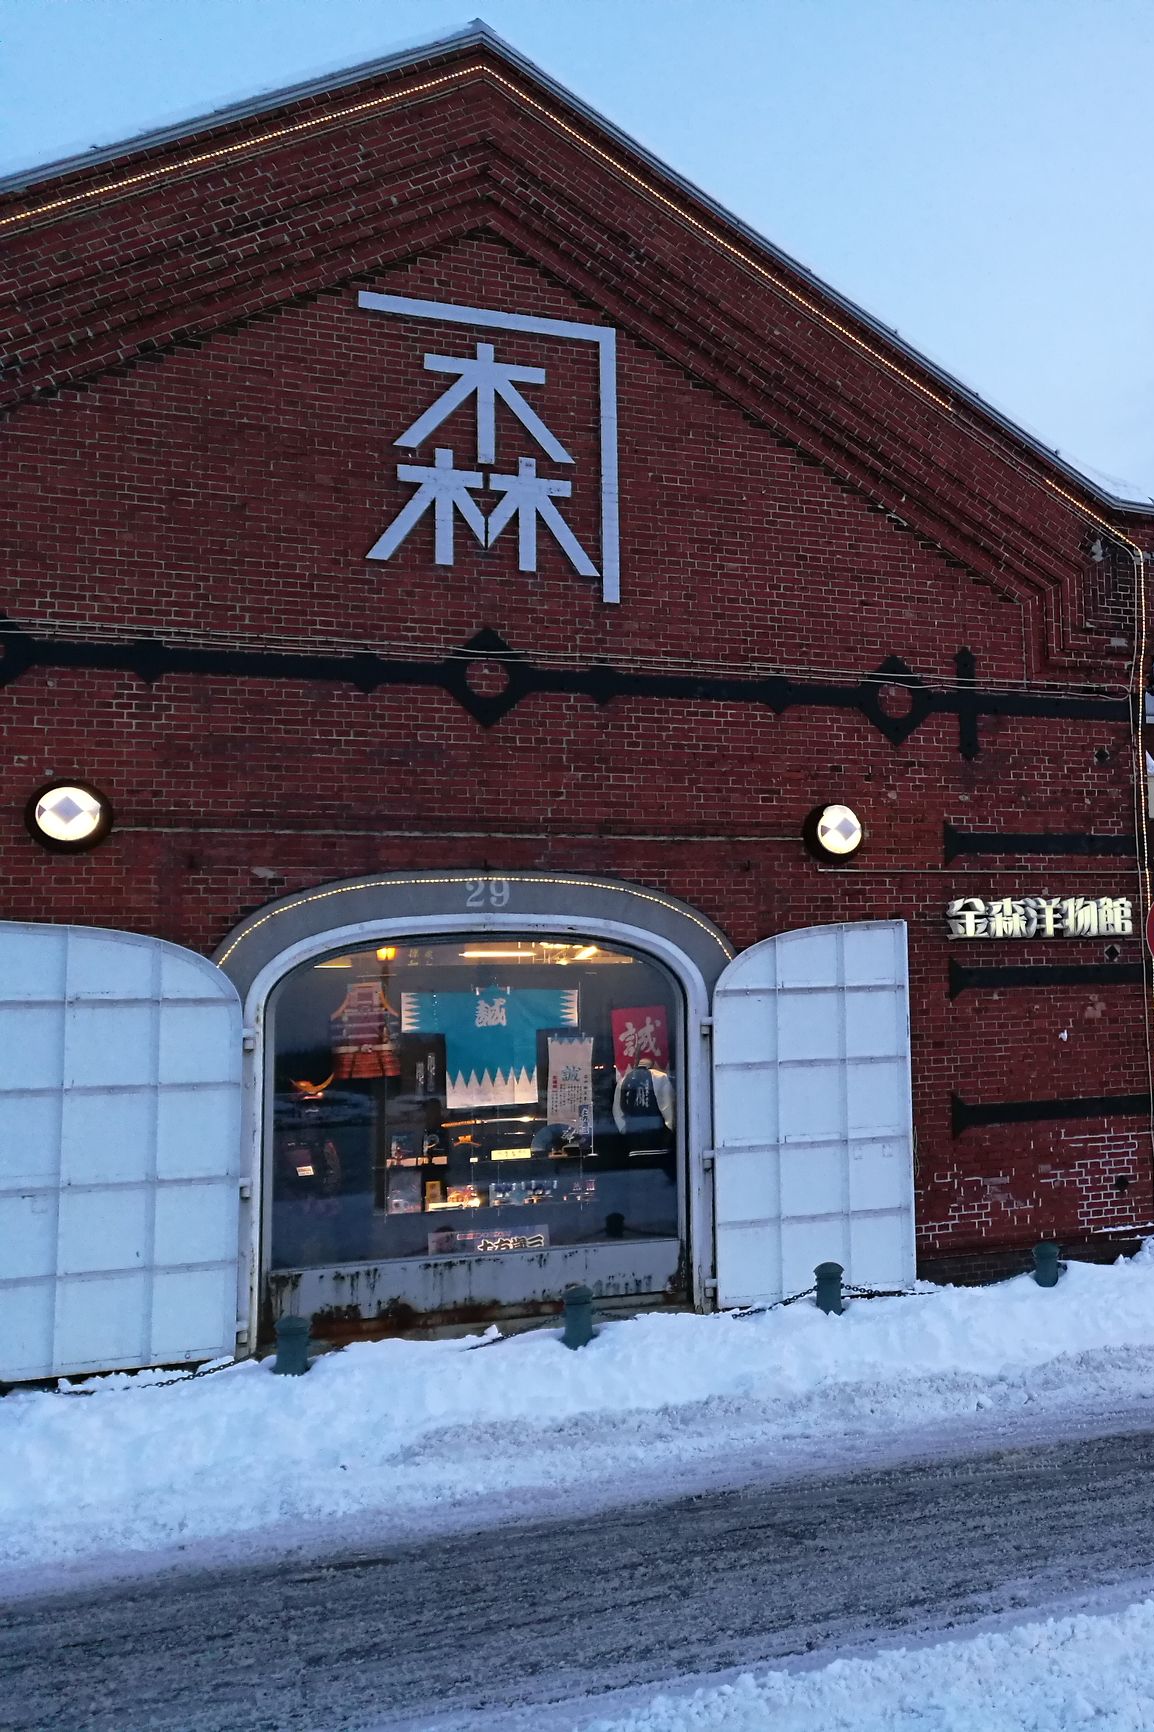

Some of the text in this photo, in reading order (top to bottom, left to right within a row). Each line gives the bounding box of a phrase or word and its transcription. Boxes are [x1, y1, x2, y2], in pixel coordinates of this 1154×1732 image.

[465, 879, 510, 907] 29
[947, 896, 1133, 938] 金森洋物館
[619, 1016, 661, 1057] 誠
